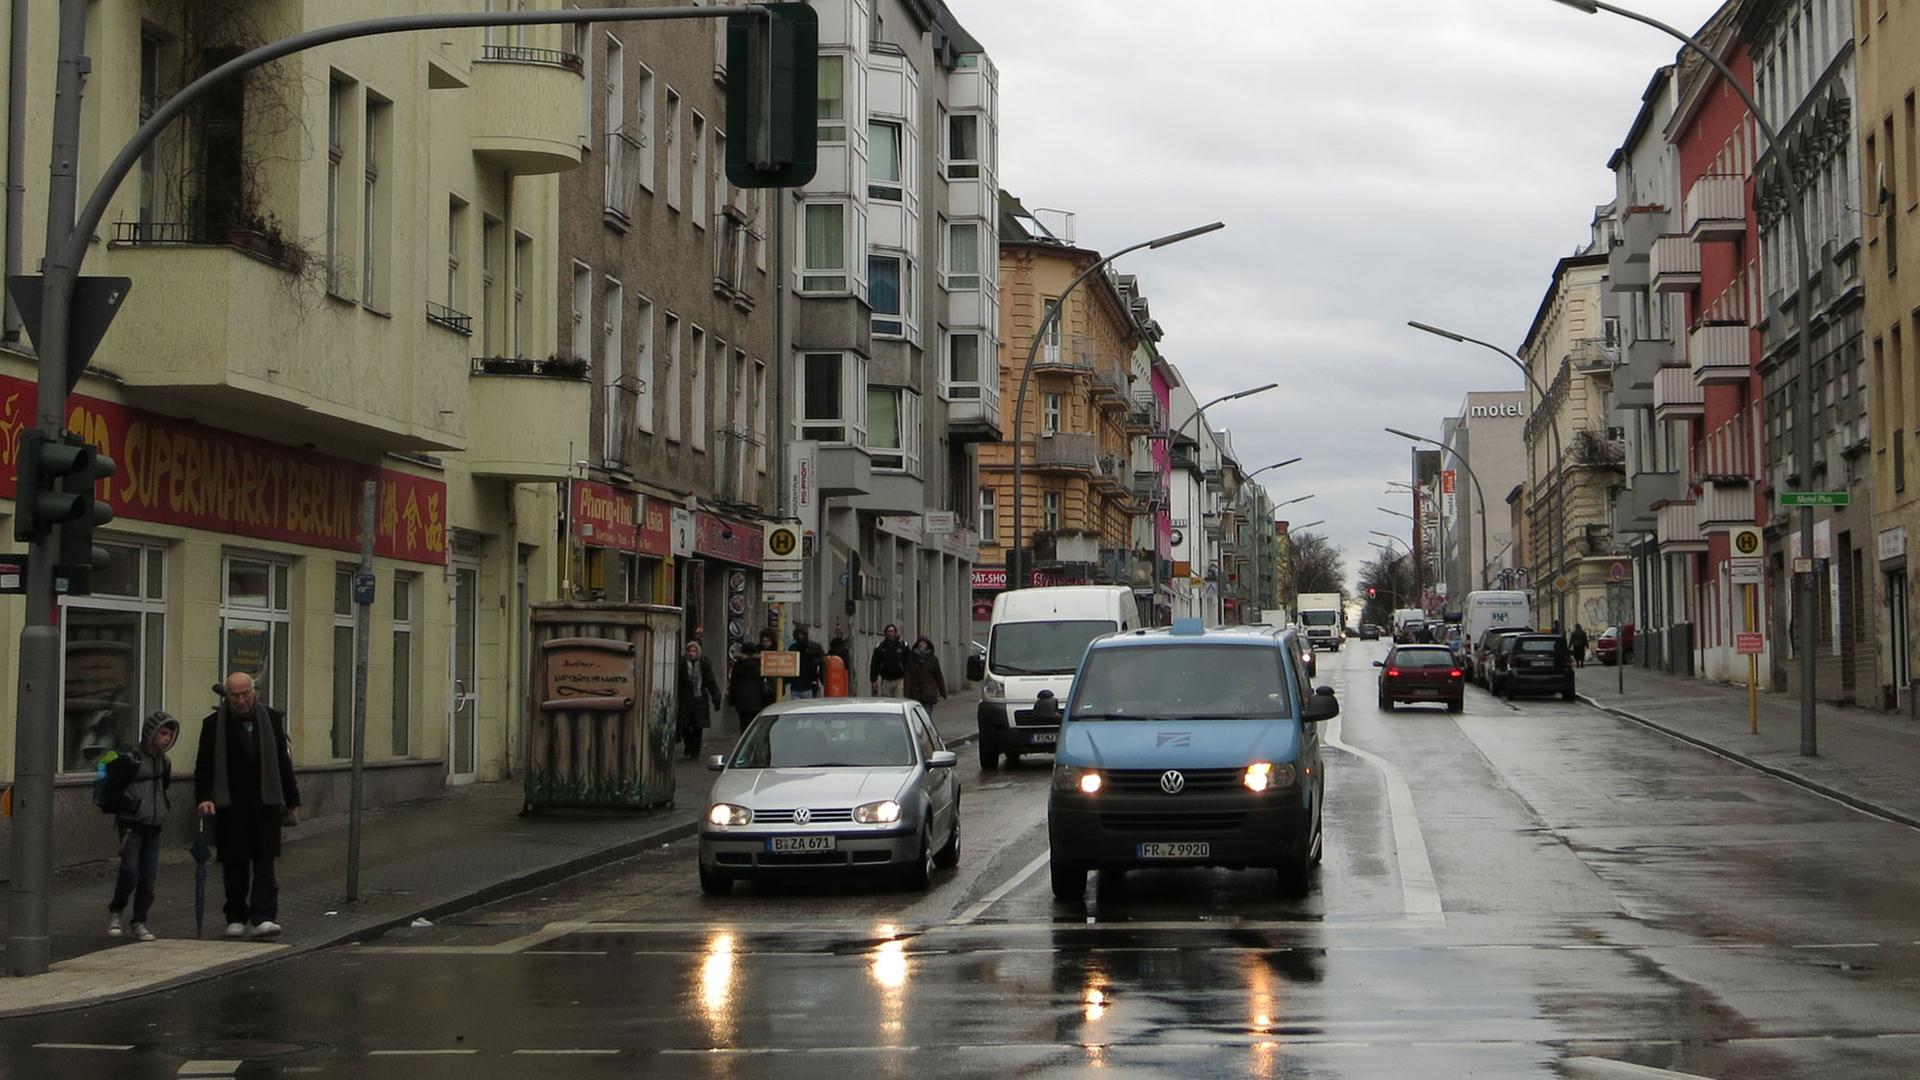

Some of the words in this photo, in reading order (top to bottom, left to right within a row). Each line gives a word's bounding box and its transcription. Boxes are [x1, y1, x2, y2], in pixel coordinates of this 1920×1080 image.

[1471, 402, 1523, 417] motel
[120, 420, 283, 529] SUPERMARKT
[287, 454, 351, 540] BERLIN
[776, 534, 788, 549] H
[1741, 537, 1752, 549] H
[775, 838, 783, 850] B
[791, 838, 805, 849] ZA
[809, 837, 830, 848] 671
[1144, 844, 1160, 855] FR
[1168, 844, 1175, 855] Z
[1178, 844, 1208, 855] 9920
